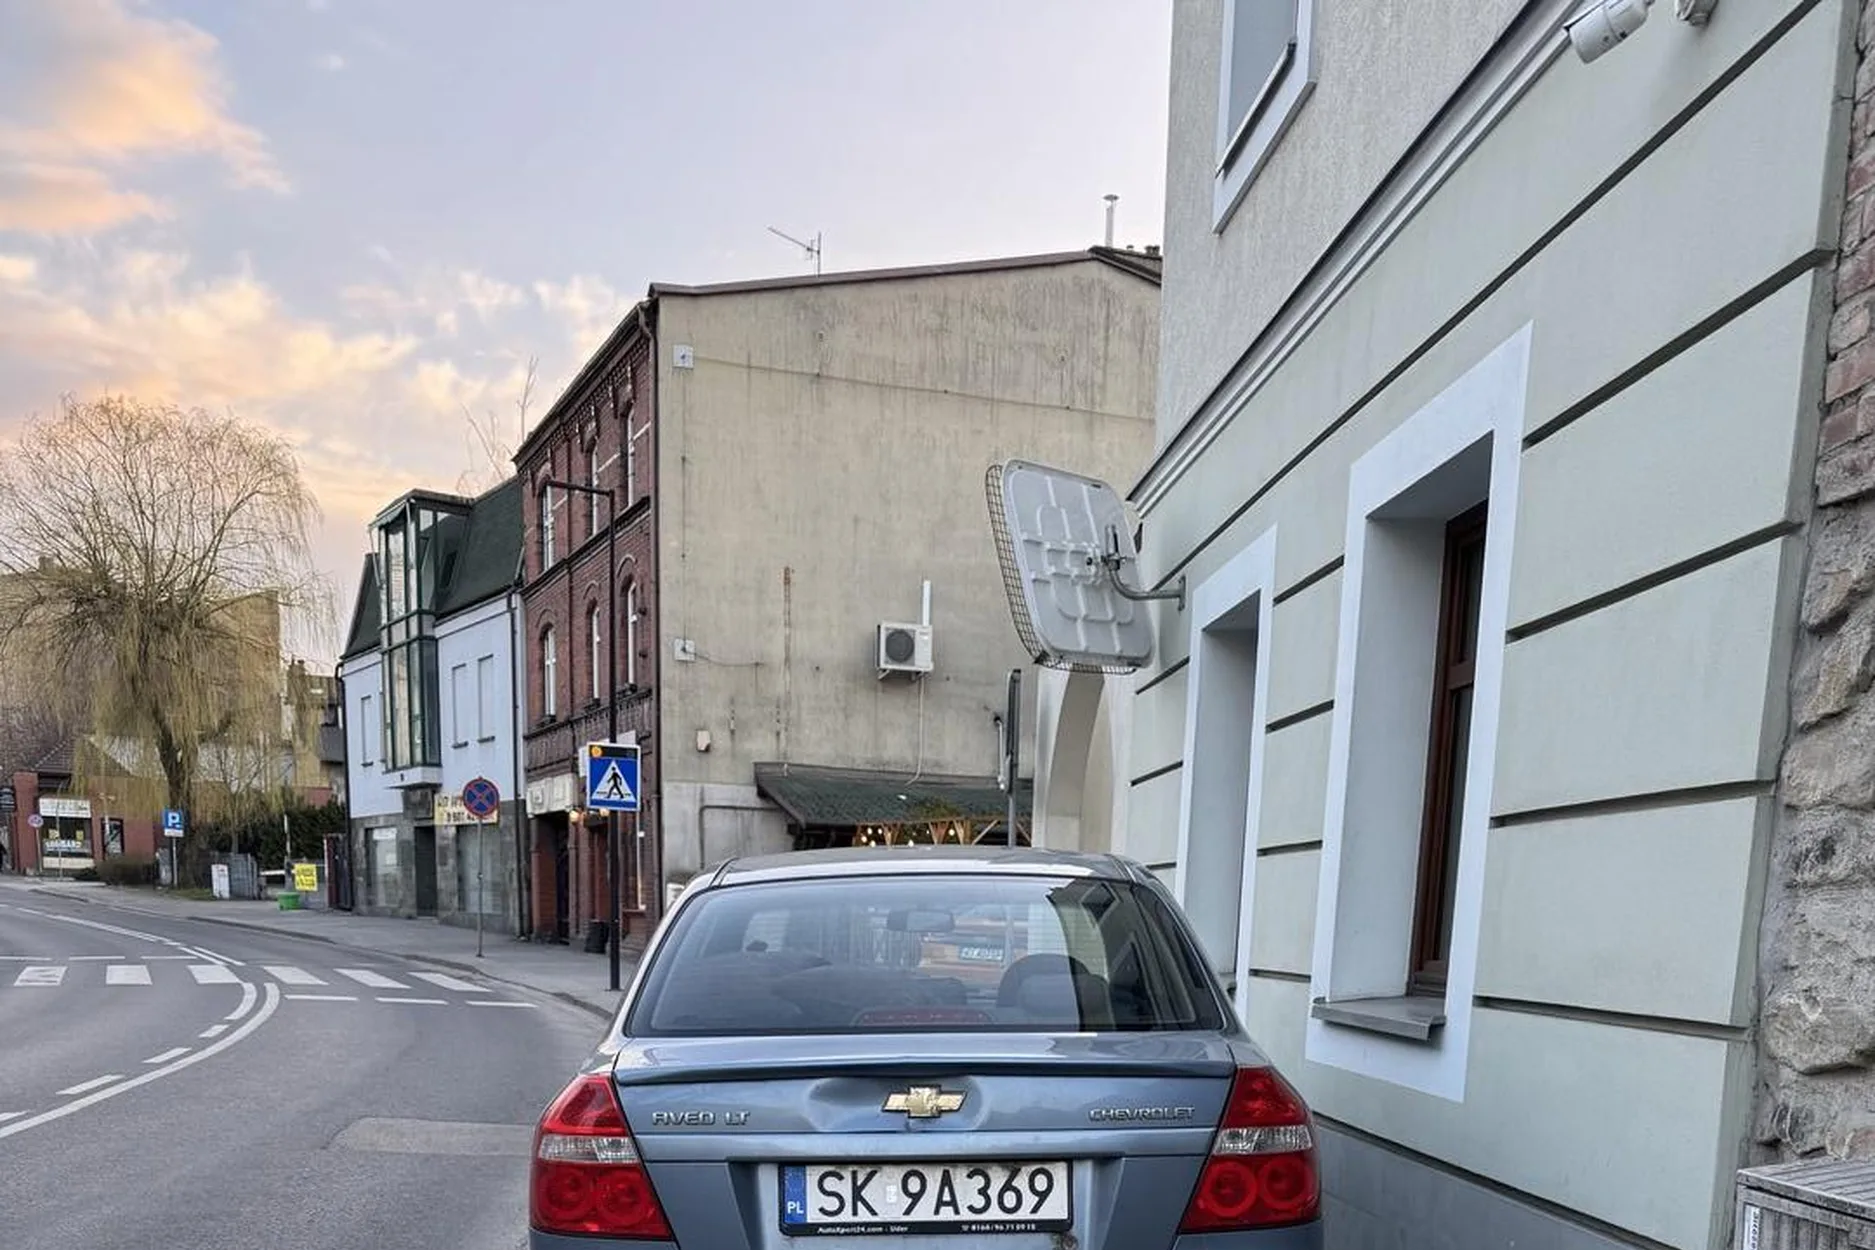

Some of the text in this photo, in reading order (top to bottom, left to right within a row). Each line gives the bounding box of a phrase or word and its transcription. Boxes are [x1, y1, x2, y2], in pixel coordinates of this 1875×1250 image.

[168, 812, 180, 827] P
[652, 1111, 751, 1126] AVEO LT
[1088, 1106, 1196, 1121] CHEVROLET
[817, 1167, 1055, 1217] SK 9A369
[787, 1201, 804, 1214] PL
